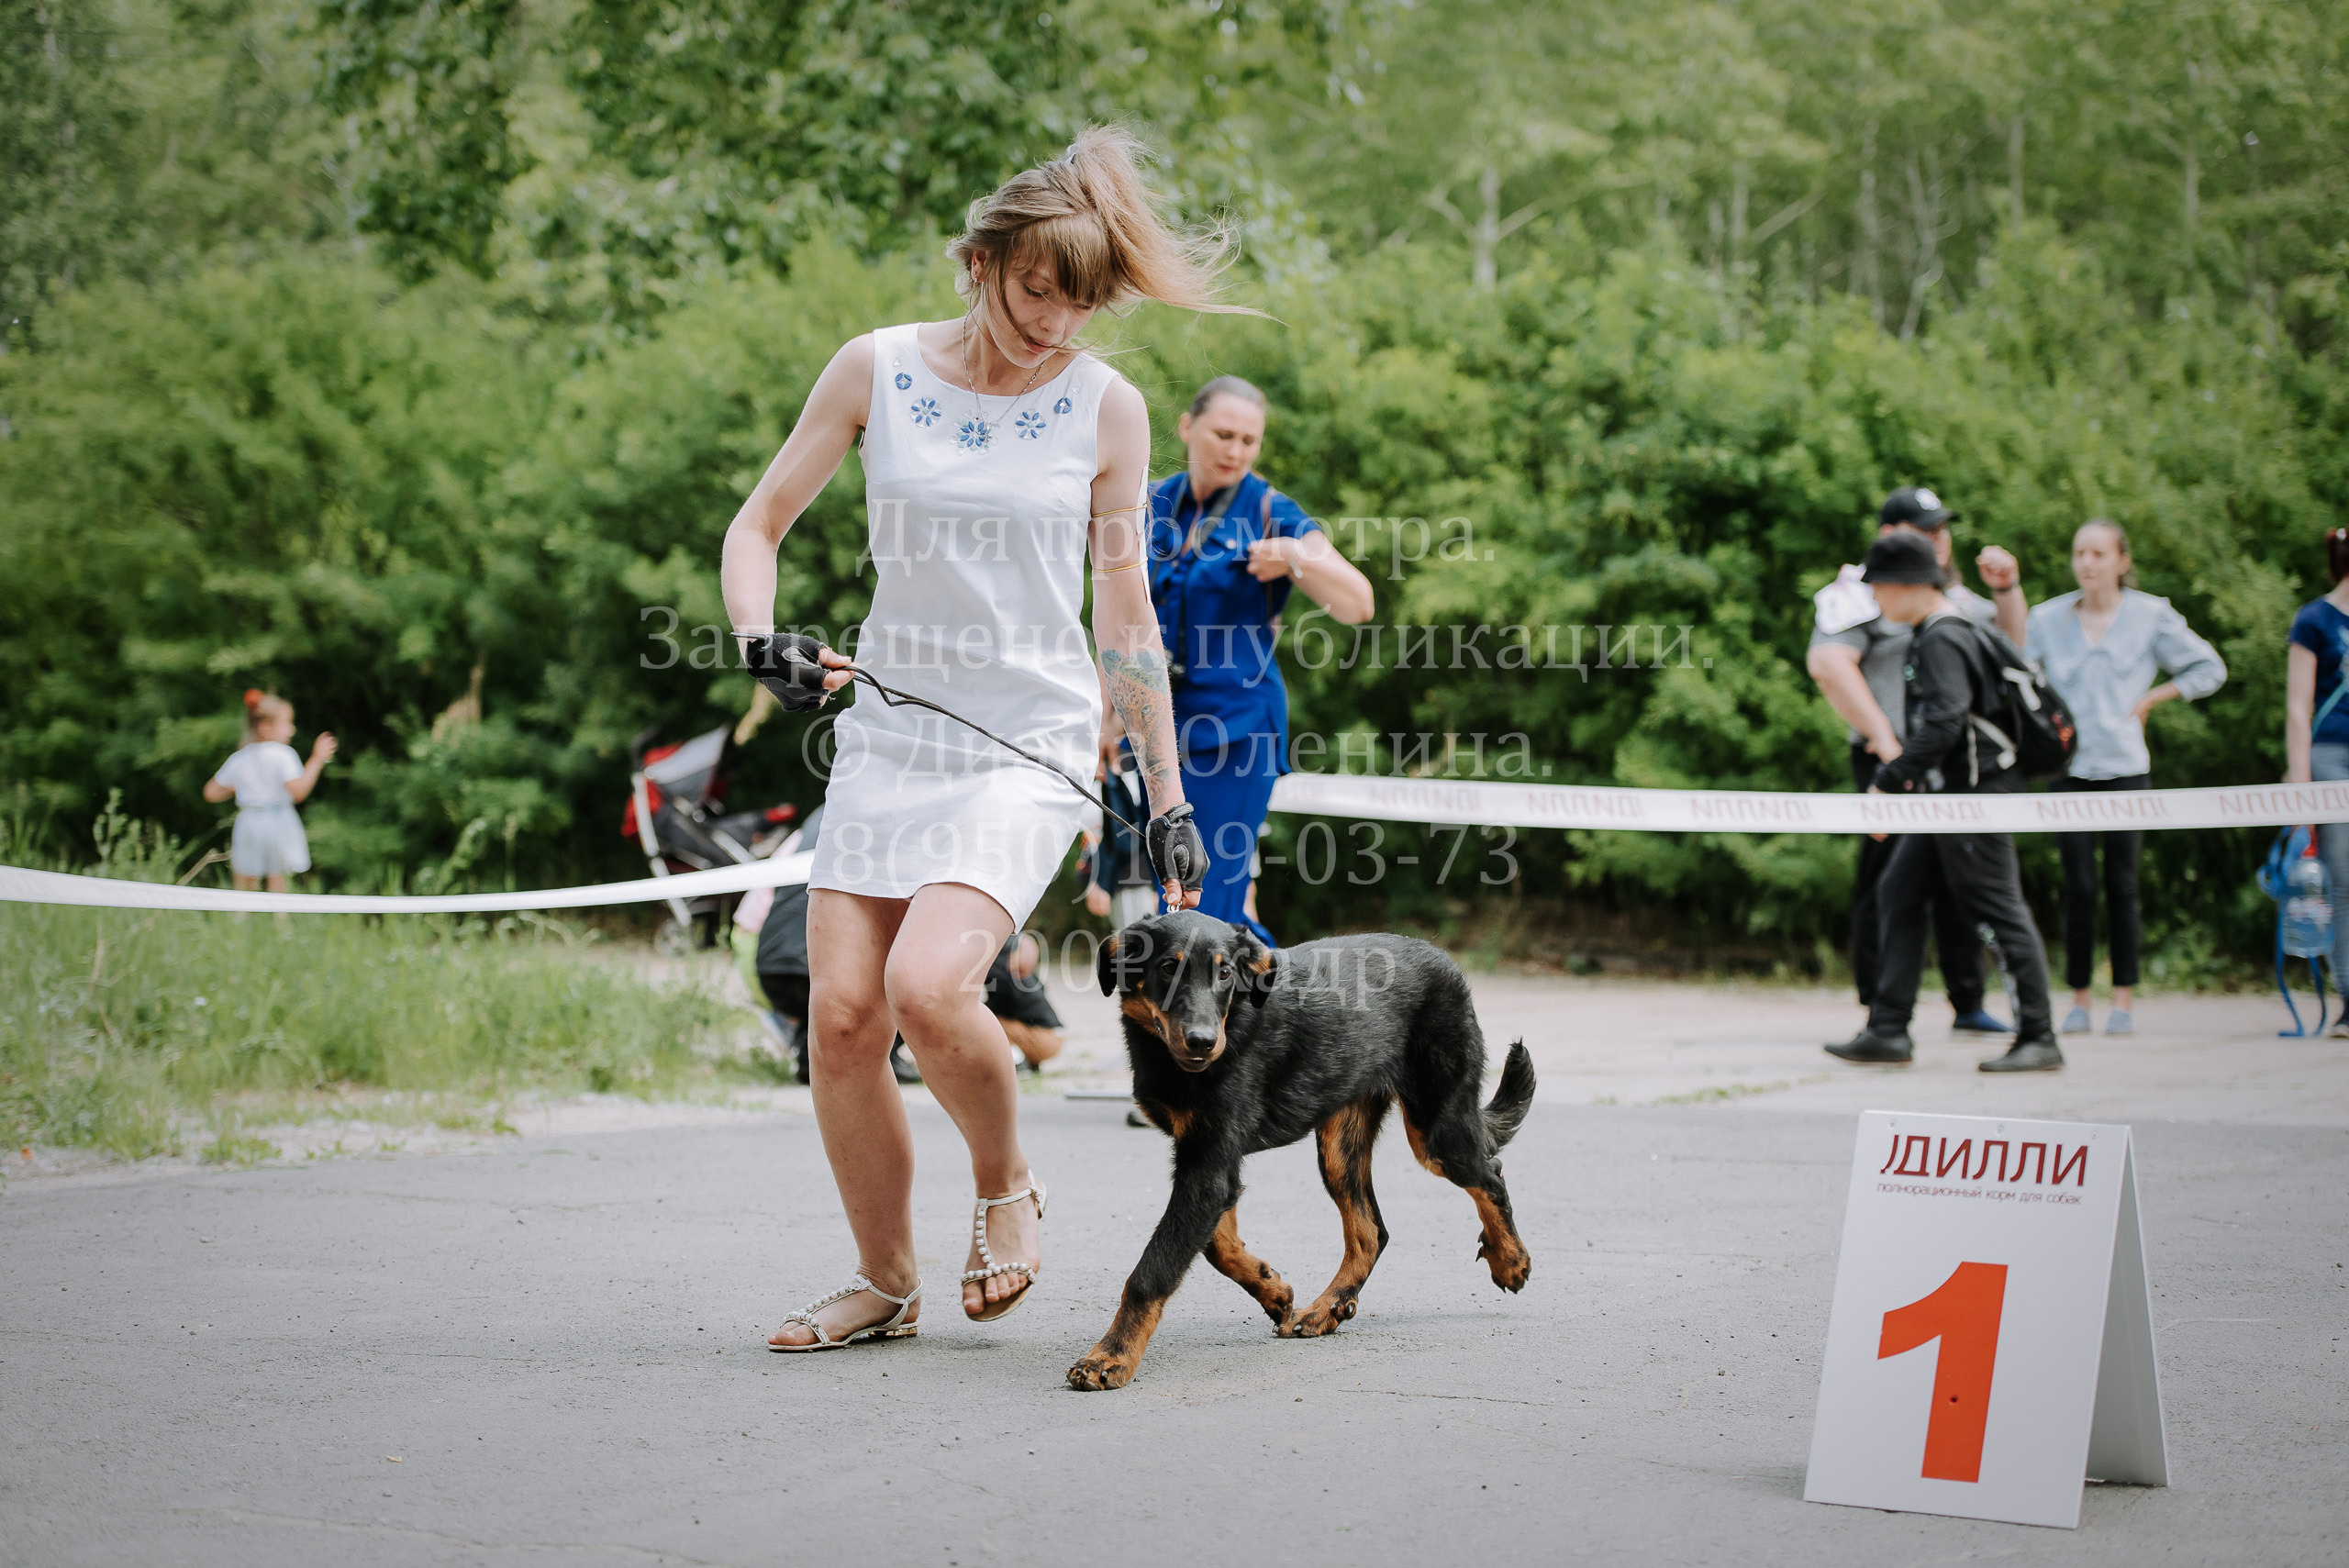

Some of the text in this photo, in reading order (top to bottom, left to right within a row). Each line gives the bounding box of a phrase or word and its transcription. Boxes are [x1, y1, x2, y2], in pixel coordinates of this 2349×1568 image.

[1876, 1182, 2082, 1206] полнорационный корм для собак
[1876, 1261, 2009, 1484] 1
